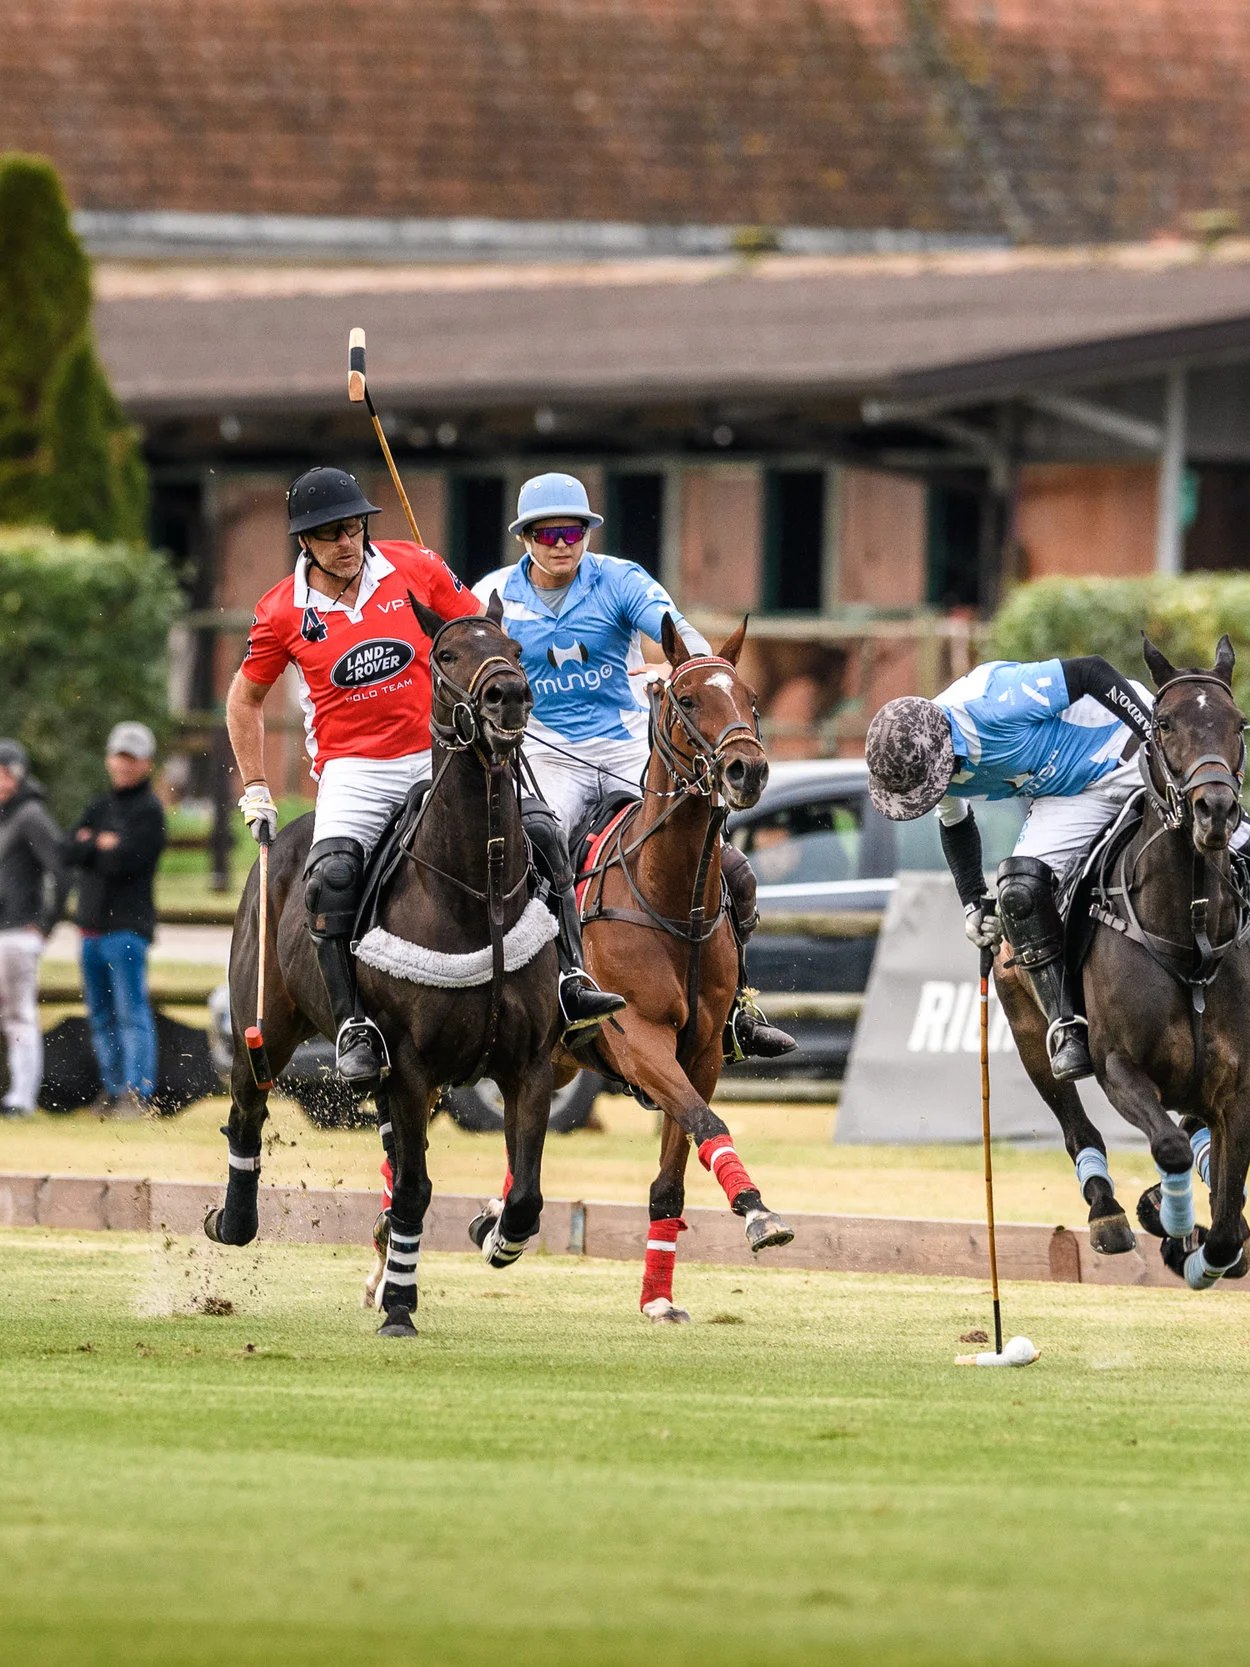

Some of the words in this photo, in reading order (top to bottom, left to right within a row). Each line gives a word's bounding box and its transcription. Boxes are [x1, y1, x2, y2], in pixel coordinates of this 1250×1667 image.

[347, 646, 385, 671] LAND
[354, 655, 400, 681] ROVER
[381, 678, 413, 694] TEAM
